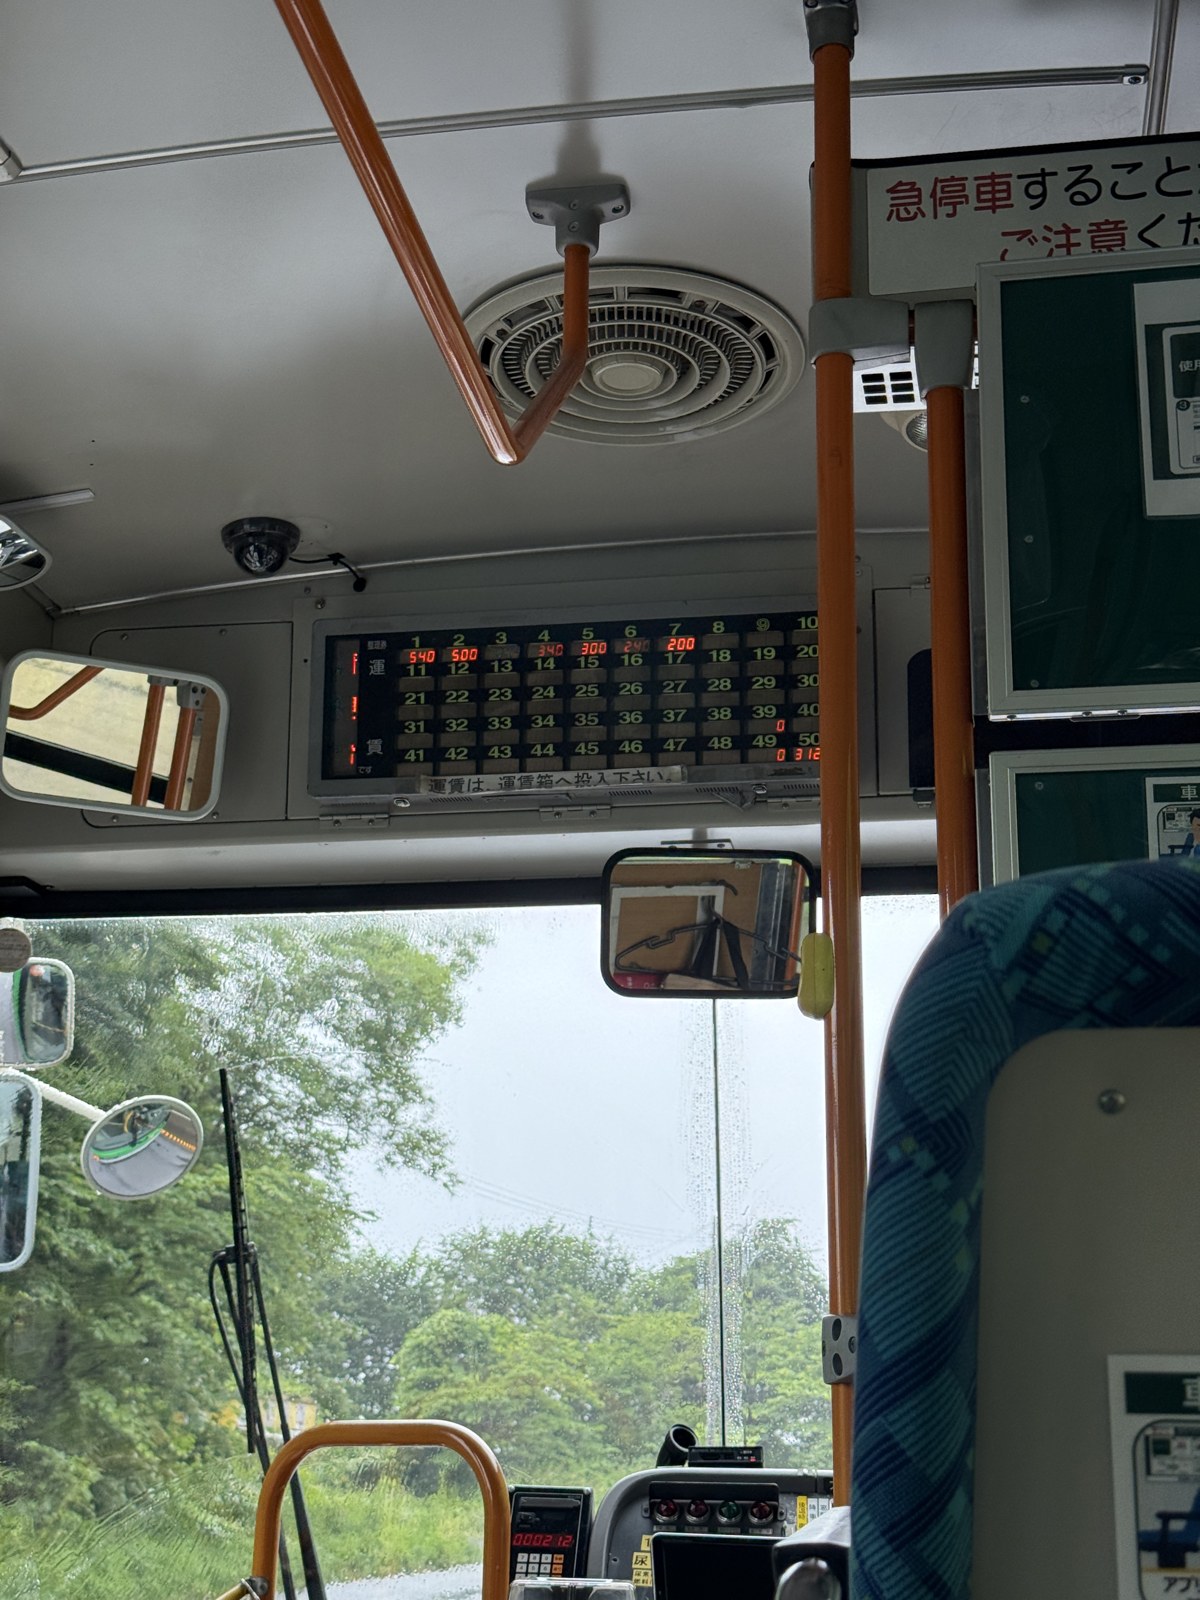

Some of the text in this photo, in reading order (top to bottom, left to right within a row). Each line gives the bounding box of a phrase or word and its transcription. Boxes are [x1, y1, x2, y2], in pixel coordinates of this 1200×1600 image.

[886, 156, 1200, 223] 急停車すること
[412, 616, 818, 648] 1 2 3 4 5 6 7 8 9 10
[407, 645, 818, 676] 11 12 13 14 15 16 17 18 19 20
[410, 650, 435, 663] 540
[452, 648, 478, 661] 500
[582, 642, 607, 655] 300
[668, 637, 695, 650] 200
[405, 674, 819, 705] 21 22 23 24 25 26 27 28 29 30
[404, 704, 820, 733] 31 32 33 34 35 36 37 38 39 40
[776, 719, 785, 732] 0
[405, 733, 820, 761] 41 42 43 44 45 46 47 48 49 50
[1181, 785, 1199, 800] 車
